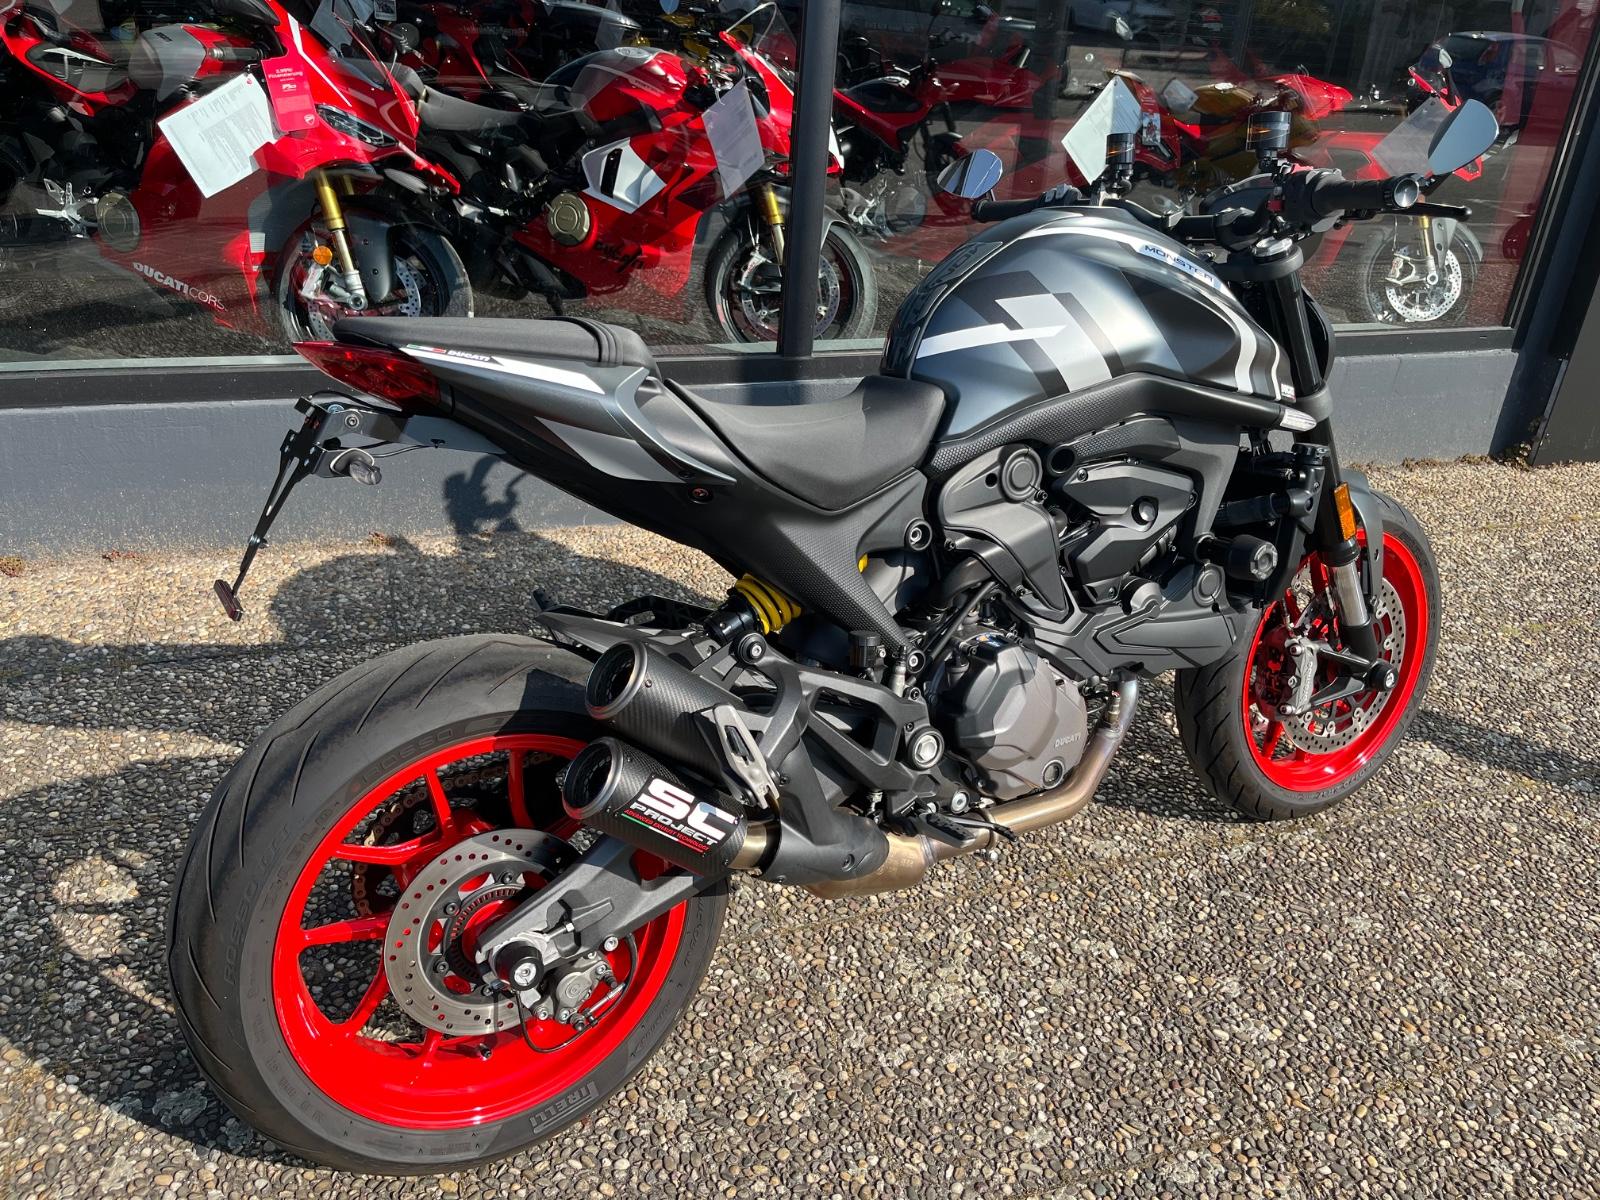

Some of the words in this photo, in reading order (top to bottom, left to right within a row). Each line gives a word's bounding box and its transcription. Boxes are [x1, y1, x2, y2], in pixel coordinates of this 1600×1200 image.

[1144, 245, 1214, 283] MONSTER
[447, 349, 491, 362] DUCATI
[1055, 732, 1082, 749] DUCATI
[623, 809, 654, 825] ADVANCED
[652, 822, 677, 837] EXHAUST
[675, 832, 710, 851] TECHNOLOGY
[629, 801, 719, 846] PROJECT
[637, 777, 738, 841] SC
[529, 1081, 600, 1134] PIRELLI
